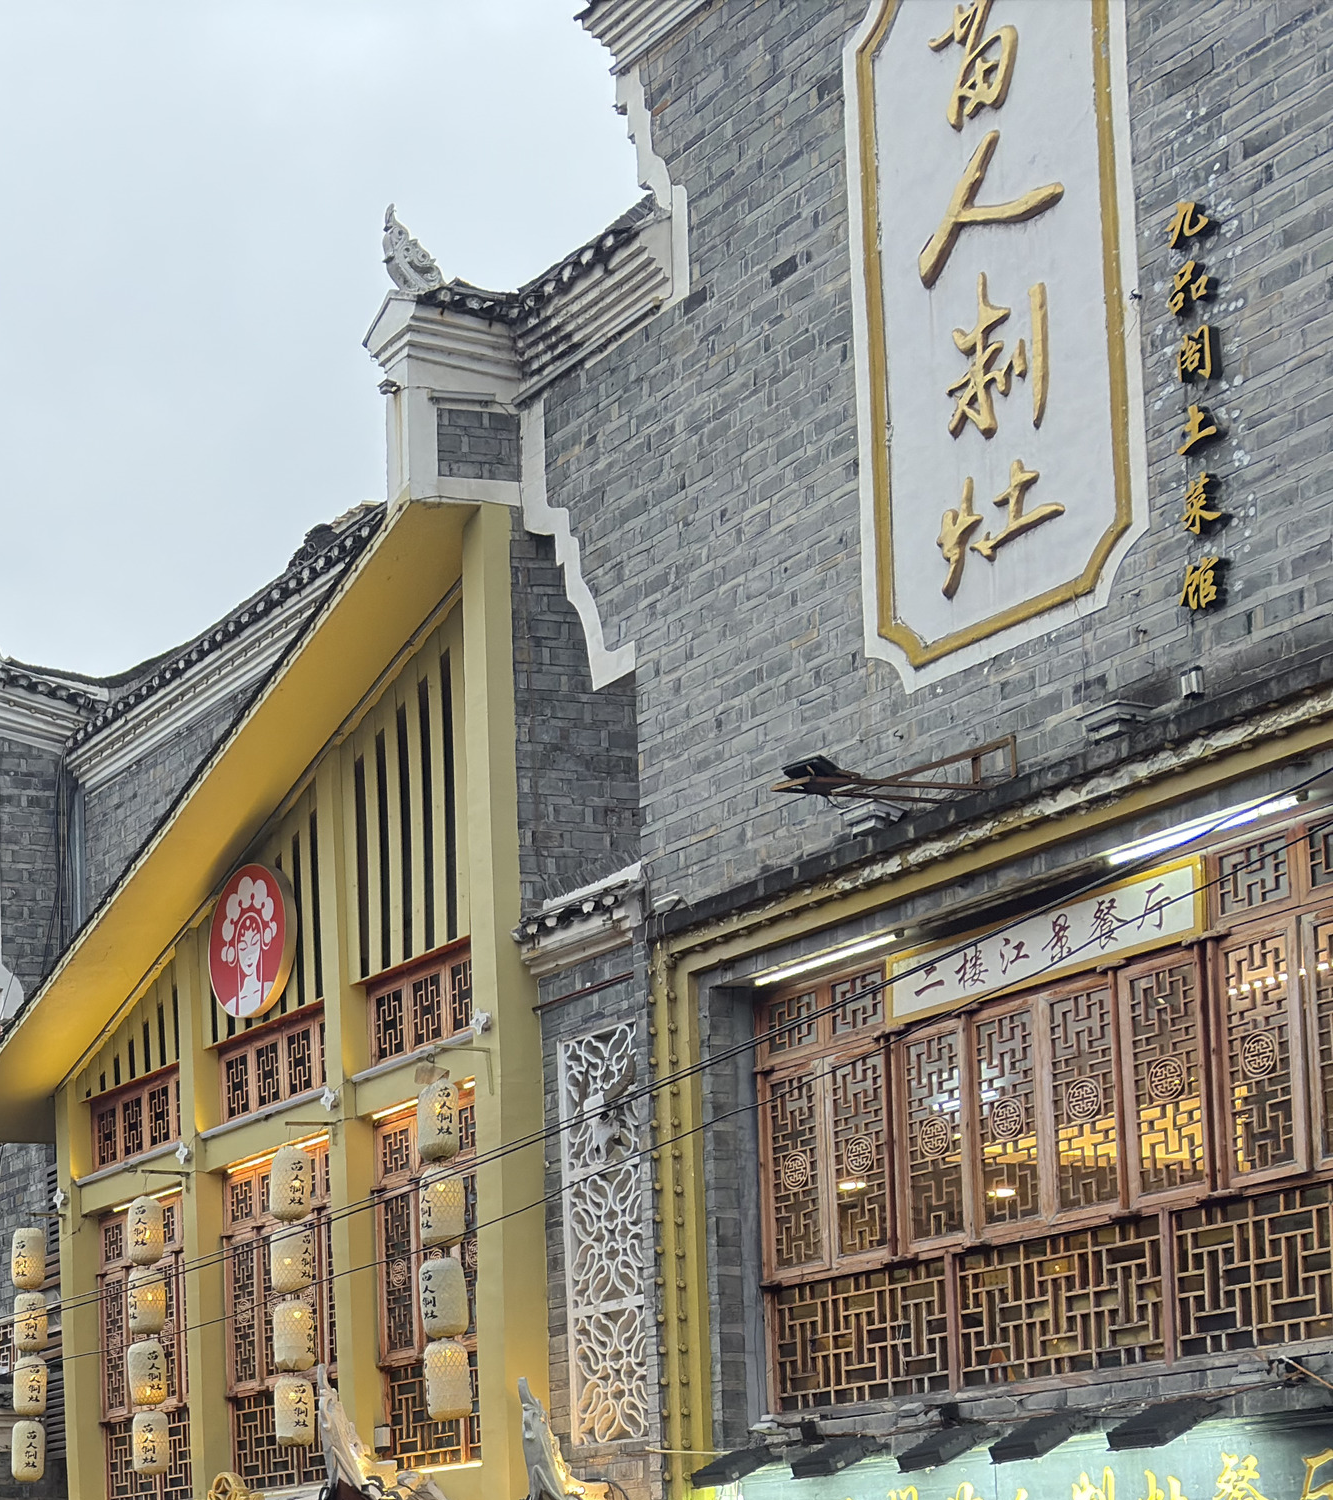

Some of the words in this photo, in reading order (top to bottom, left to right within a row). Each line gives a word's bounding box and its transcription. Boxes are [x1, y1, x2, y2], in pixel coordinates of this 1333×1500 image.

[914, 882, 1172, 997] 二楼江景餐厅
